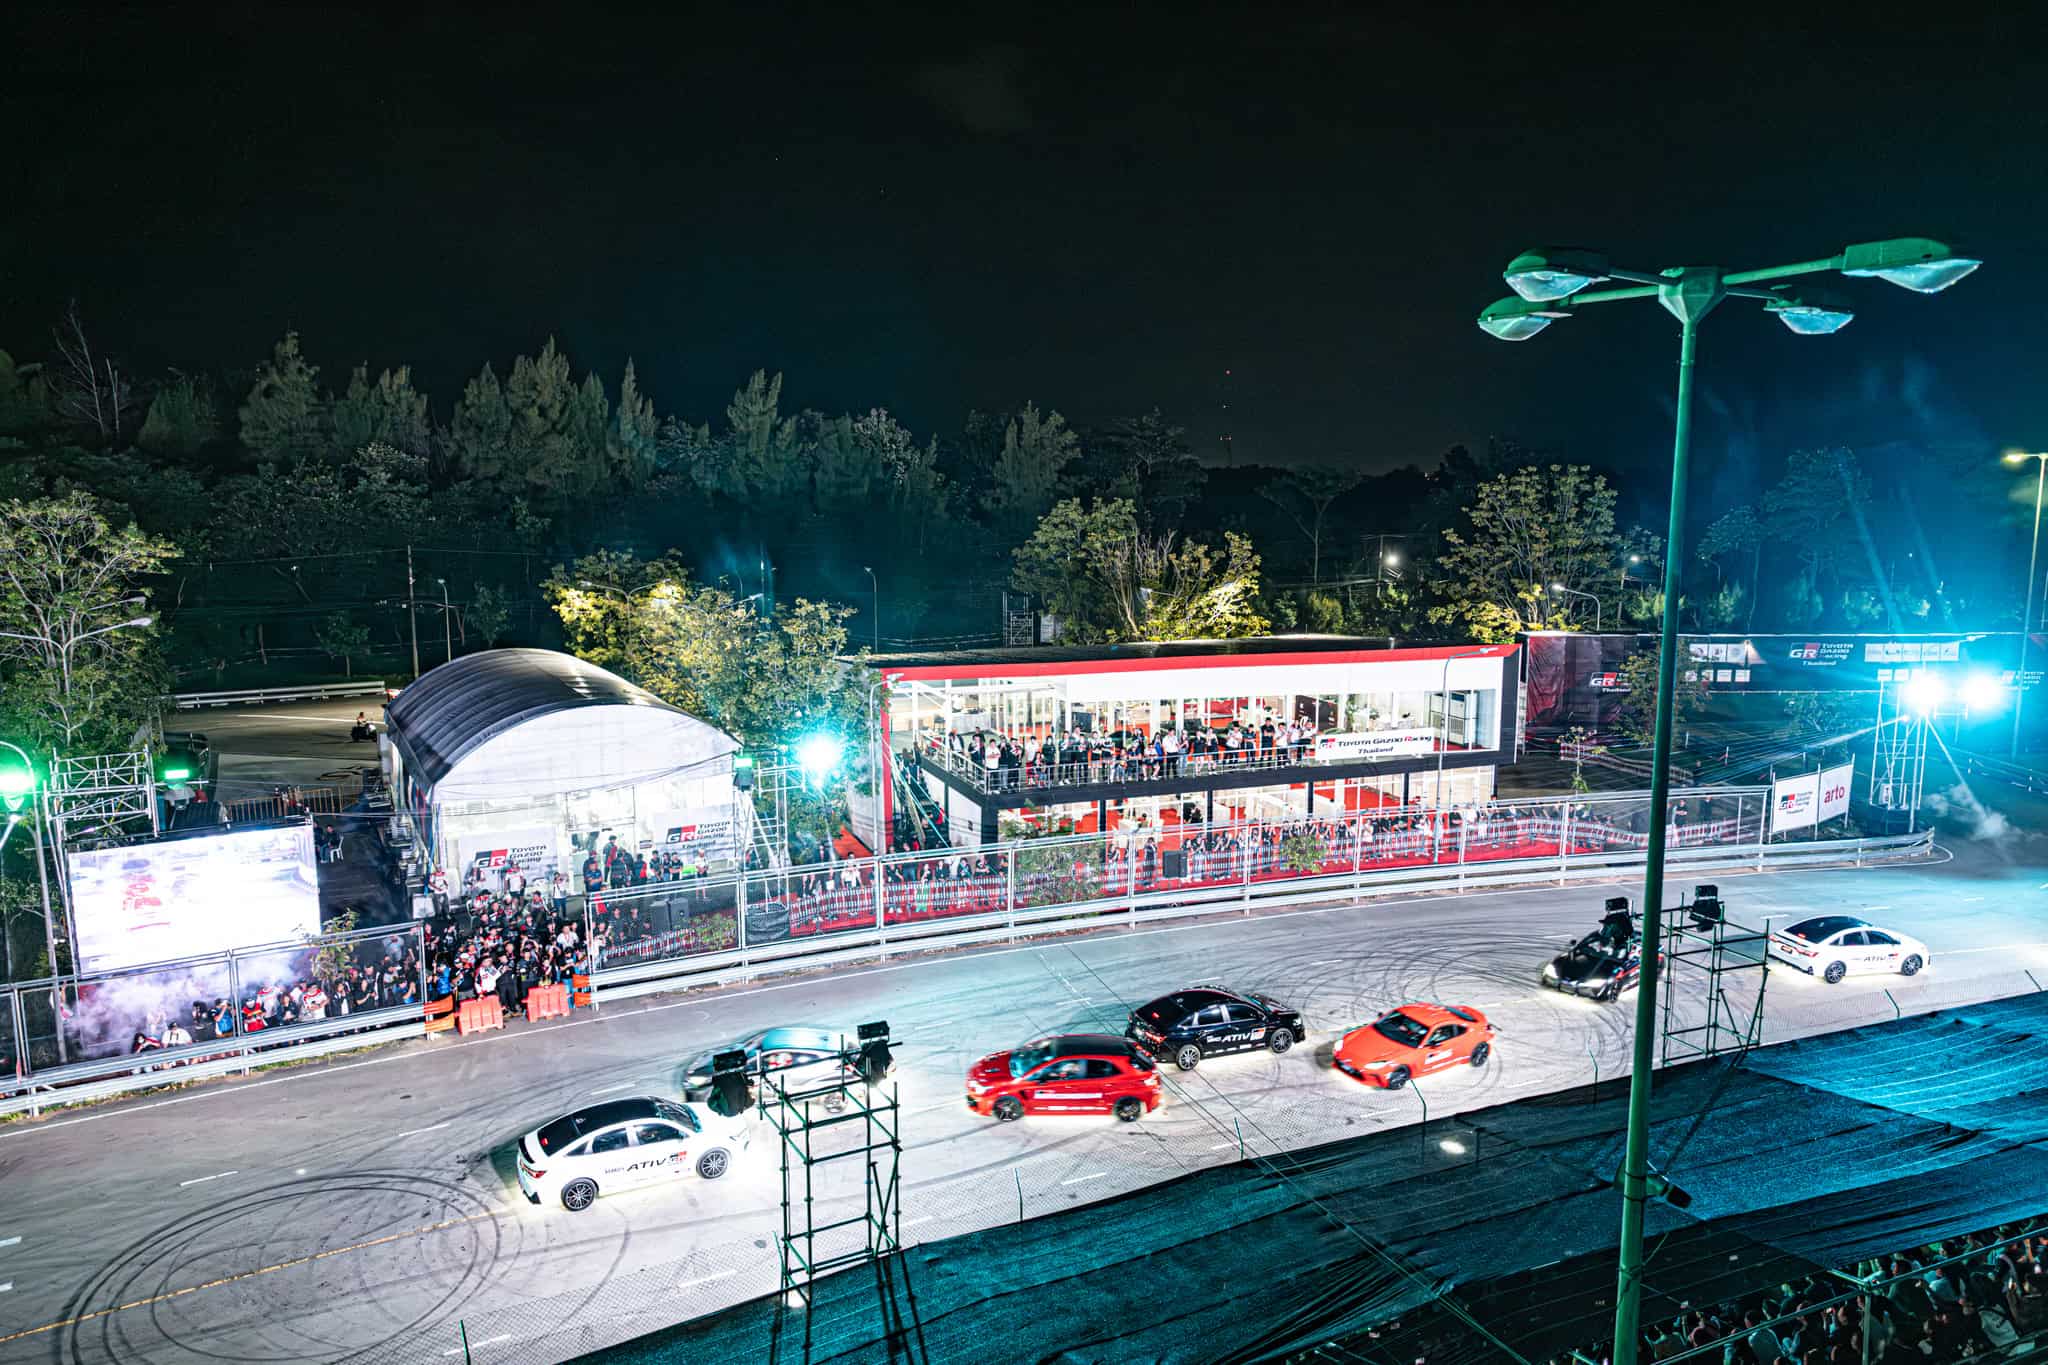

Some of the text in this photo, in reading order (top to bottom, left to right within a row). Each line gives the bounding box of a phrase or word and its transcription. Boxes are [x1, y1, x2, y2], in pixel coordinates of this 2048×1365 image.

[1823, 785, 1845, 804] arto
[667, 830, 695, 844] GR
[510, 851, 543, 859] GAZOO
[511, 845, 547, 853] TOYOTA
[475, 854, 507, 868] GR
[1222, 1032, 1251, 1043] ATIV
[626, 1158, 666, 1172] ATIV
